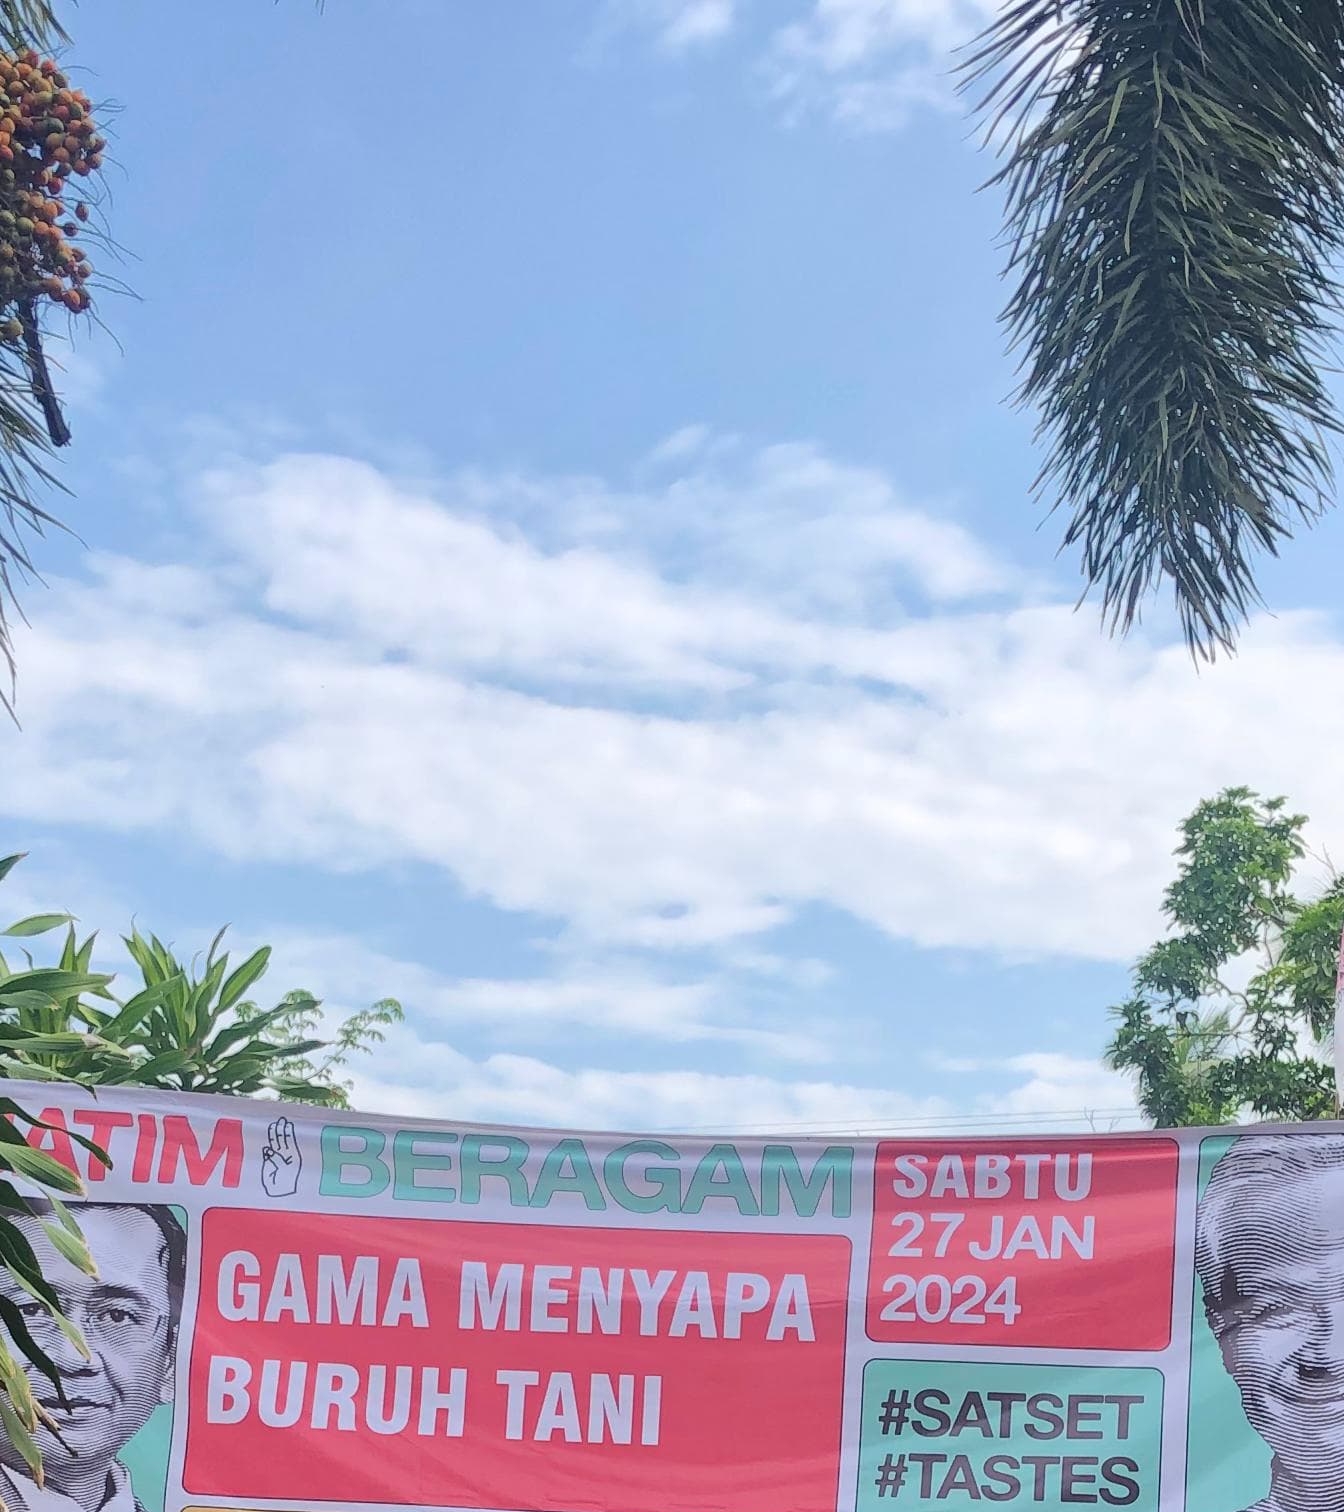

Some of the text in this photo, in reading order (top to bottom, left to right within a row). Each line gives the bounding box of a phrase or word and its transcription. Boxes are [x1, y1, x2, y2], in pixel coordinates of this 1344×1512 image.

[318, 1125, 854, 1219] BERAGAM
[892, 1153, 1093, 1202] SABTU
[888, 1213, 1096, 1261] 27 JAN
[217, 1250, 816, 1343] GAMA MENYAPA
[879, 1274, 1021, 1326] 2024
[207, 1355, 663, 1447] BURUH TANI
[878, 1389, 1145, 1441] #SATSET
[875, 1452, 1141, 1506] #TASTES
